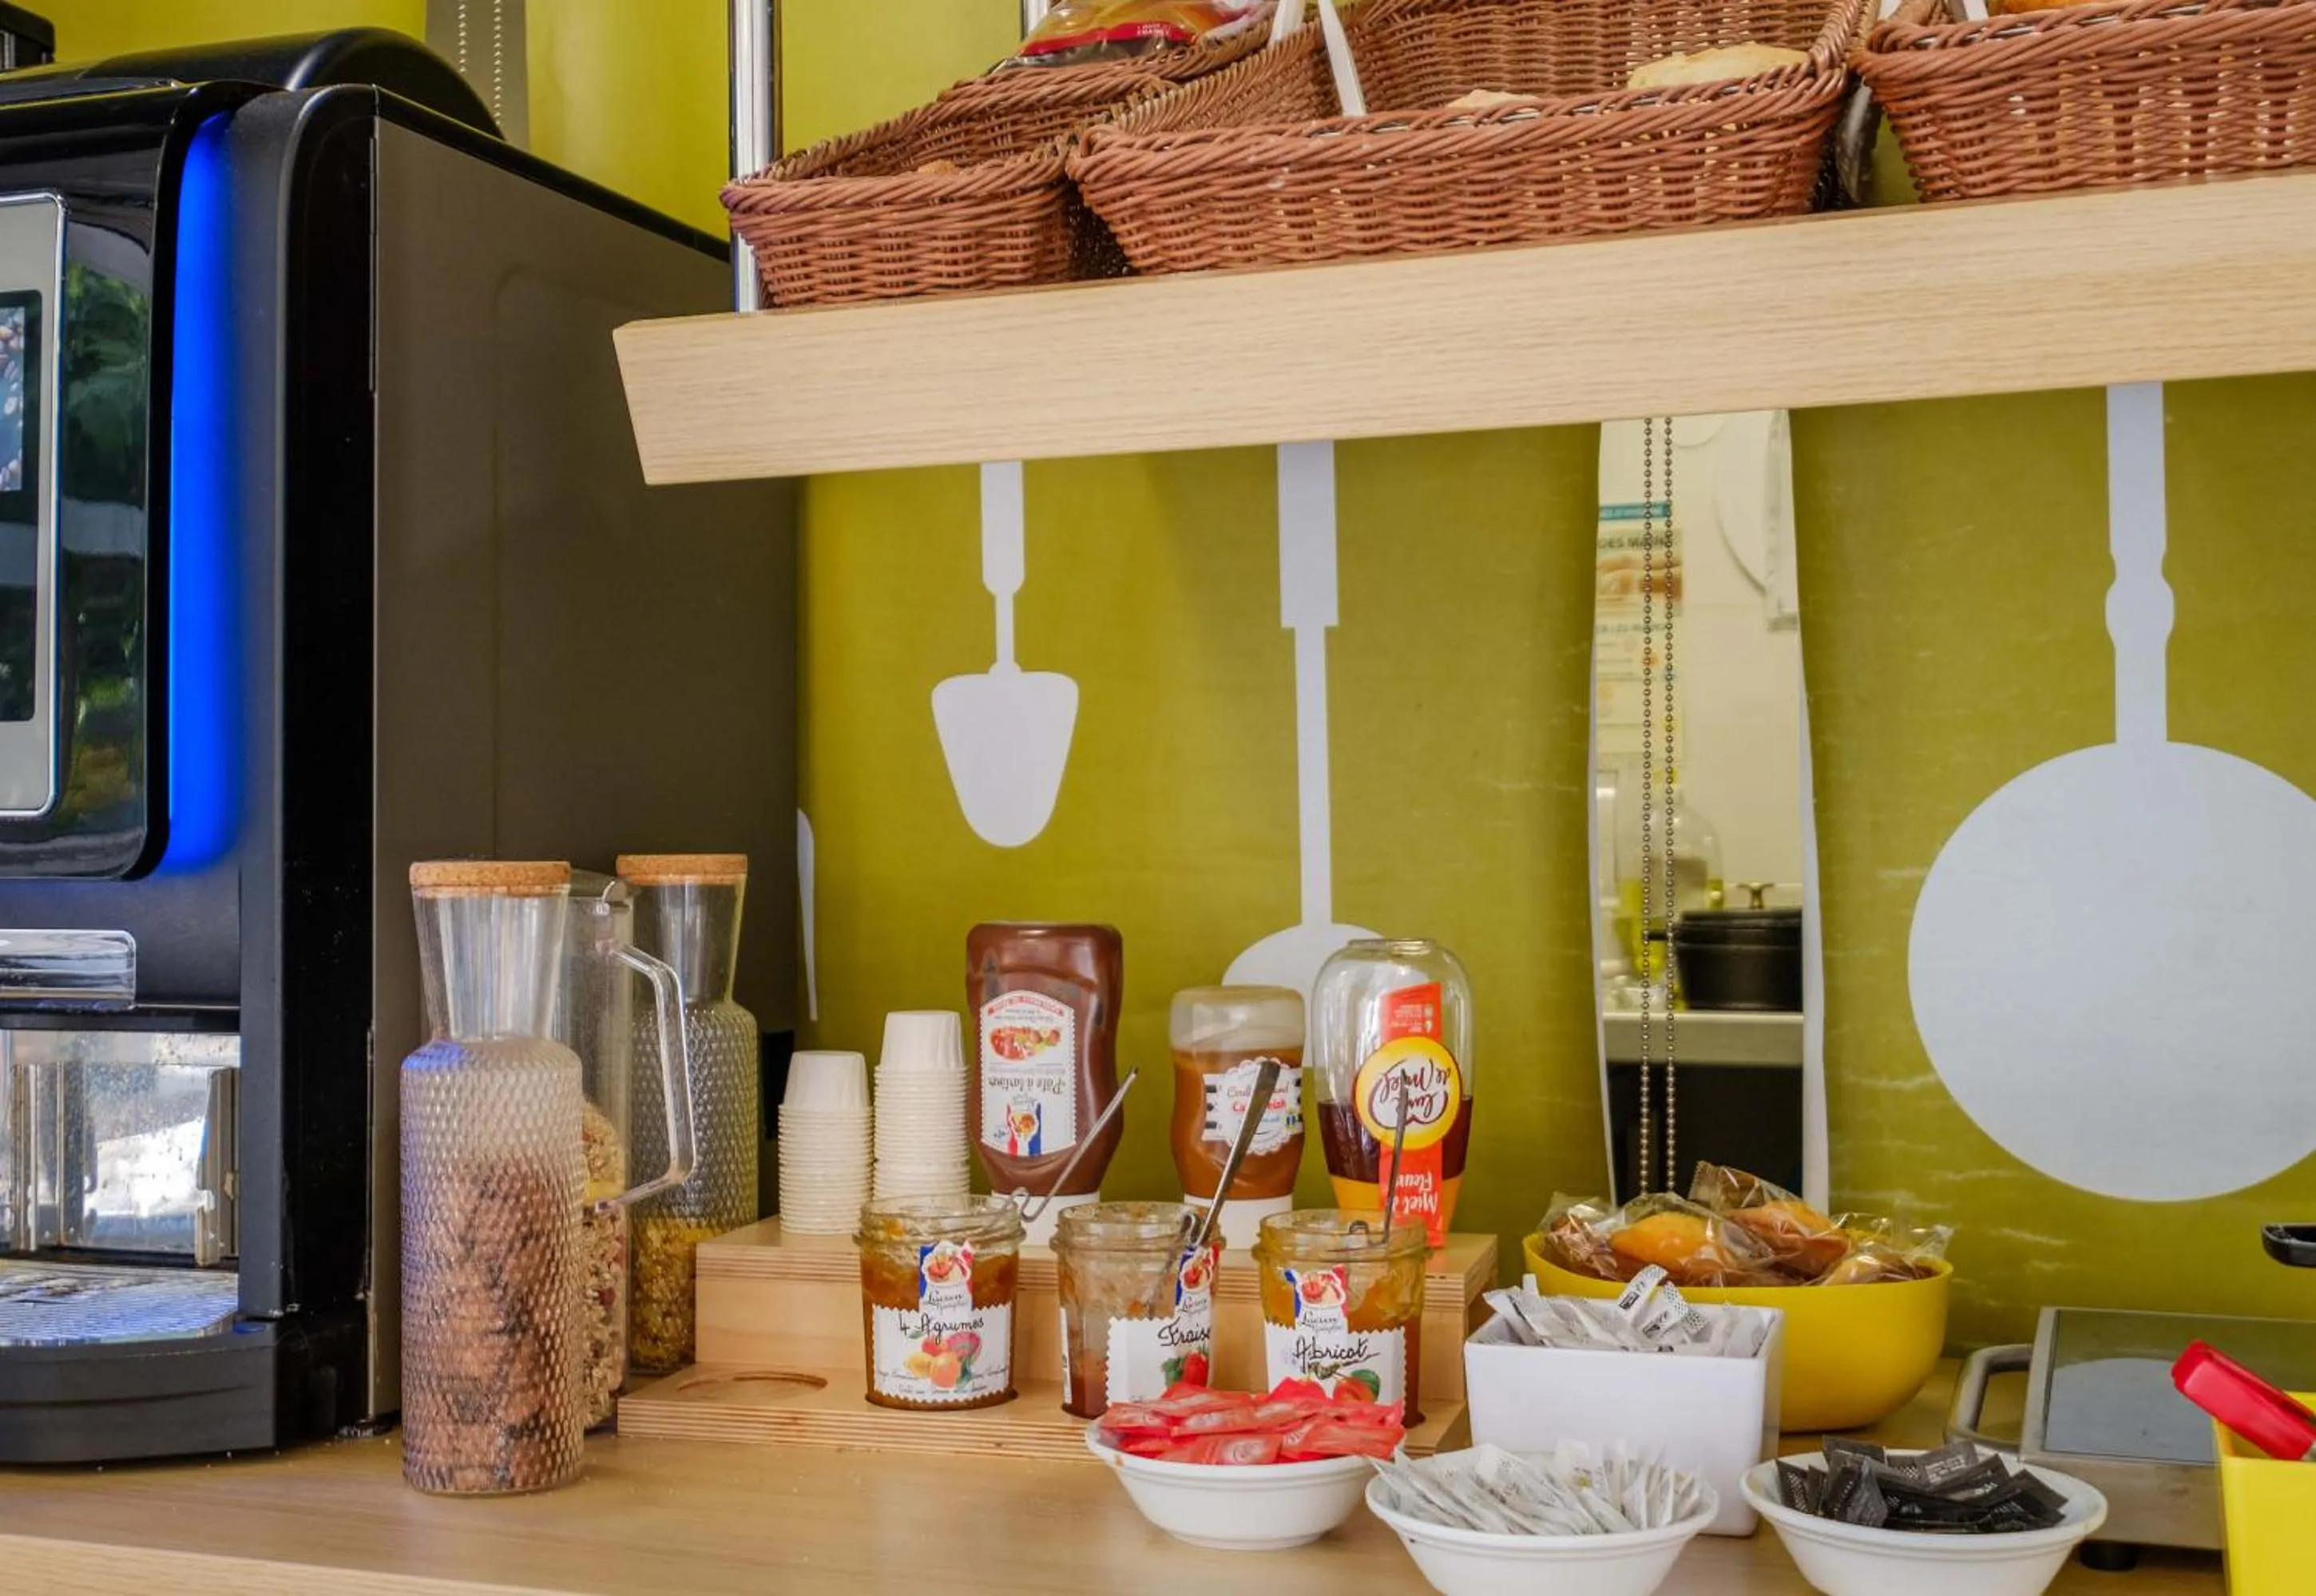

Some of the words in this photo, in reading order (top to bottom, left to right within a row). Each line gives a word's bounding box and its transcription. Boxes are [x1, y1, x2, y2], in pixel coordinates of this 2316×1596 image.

[1403, 1191, 1438, 1215] Miel
[898, 1313, 910, 1337] 4
[1293, 1334, 1369, 1374] Abricot
